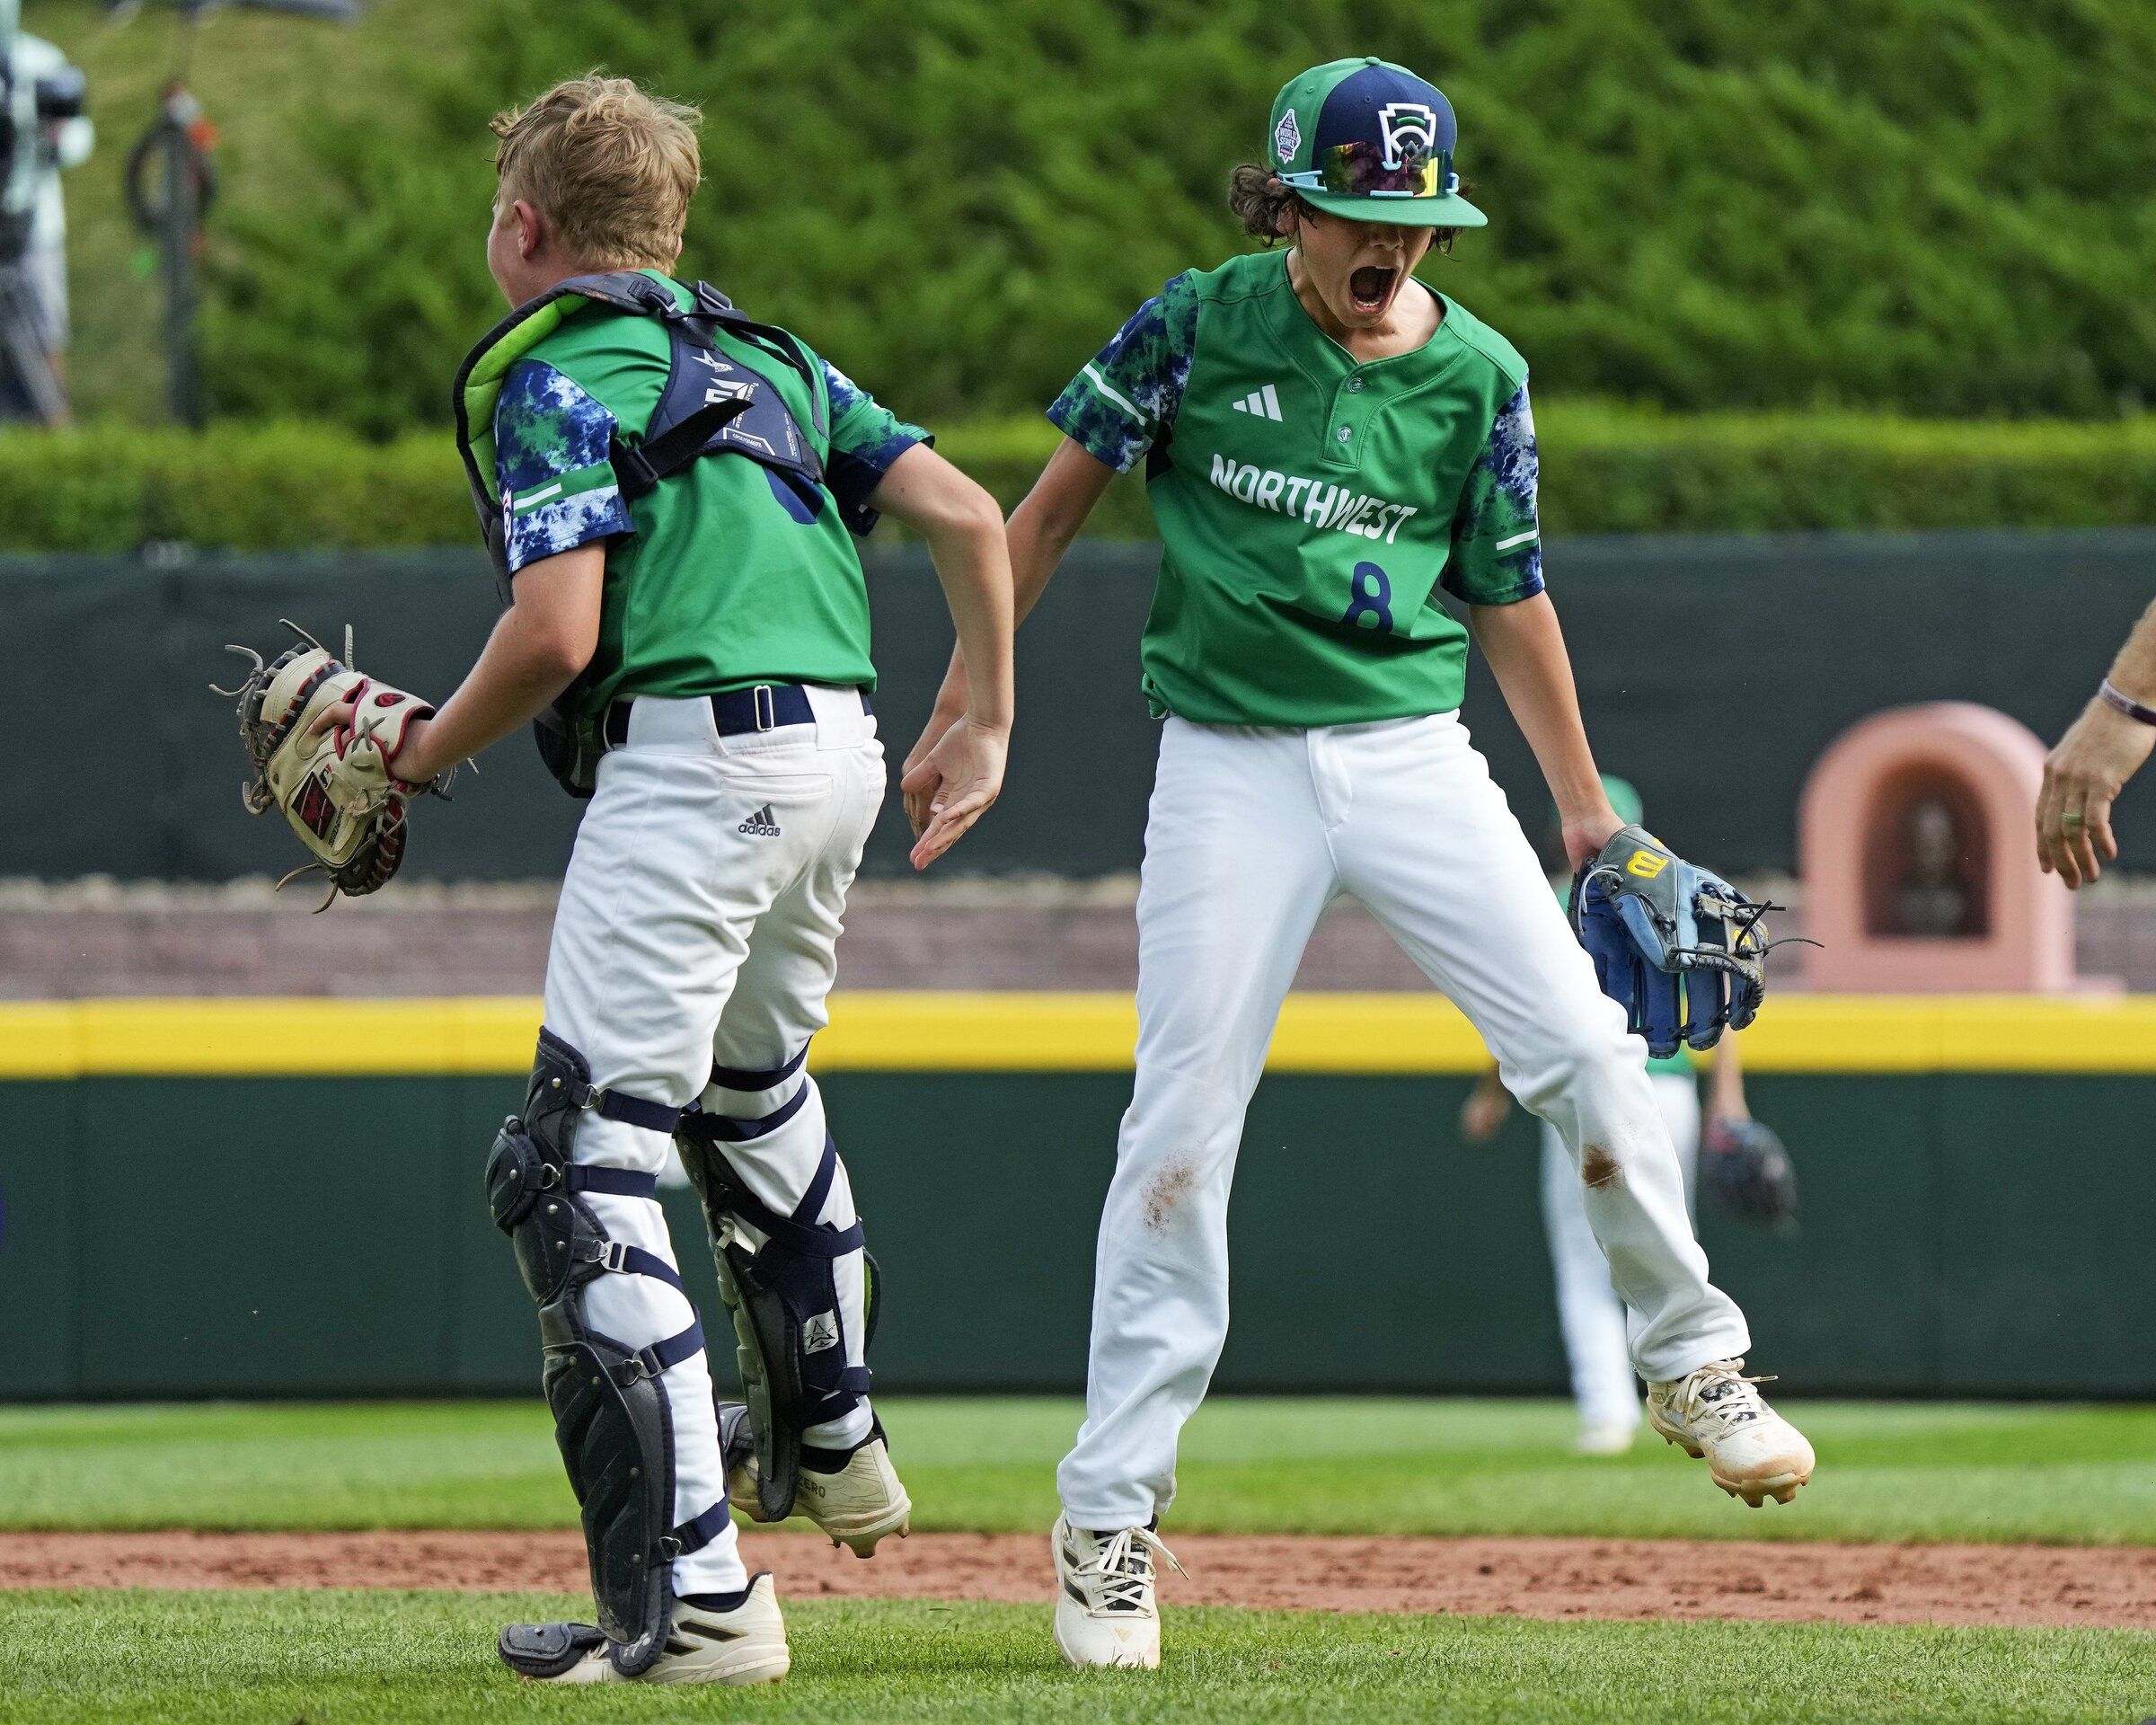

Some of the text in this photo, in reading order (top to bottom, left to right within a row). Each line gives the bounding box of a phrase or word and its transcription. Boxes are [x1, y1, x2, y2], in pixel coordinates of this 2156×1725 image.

[1210, 454, 1418, 544] NORTHWEST
[1339, 561, 1393, 633] 8
[738, 823, 781, 836] adidas
